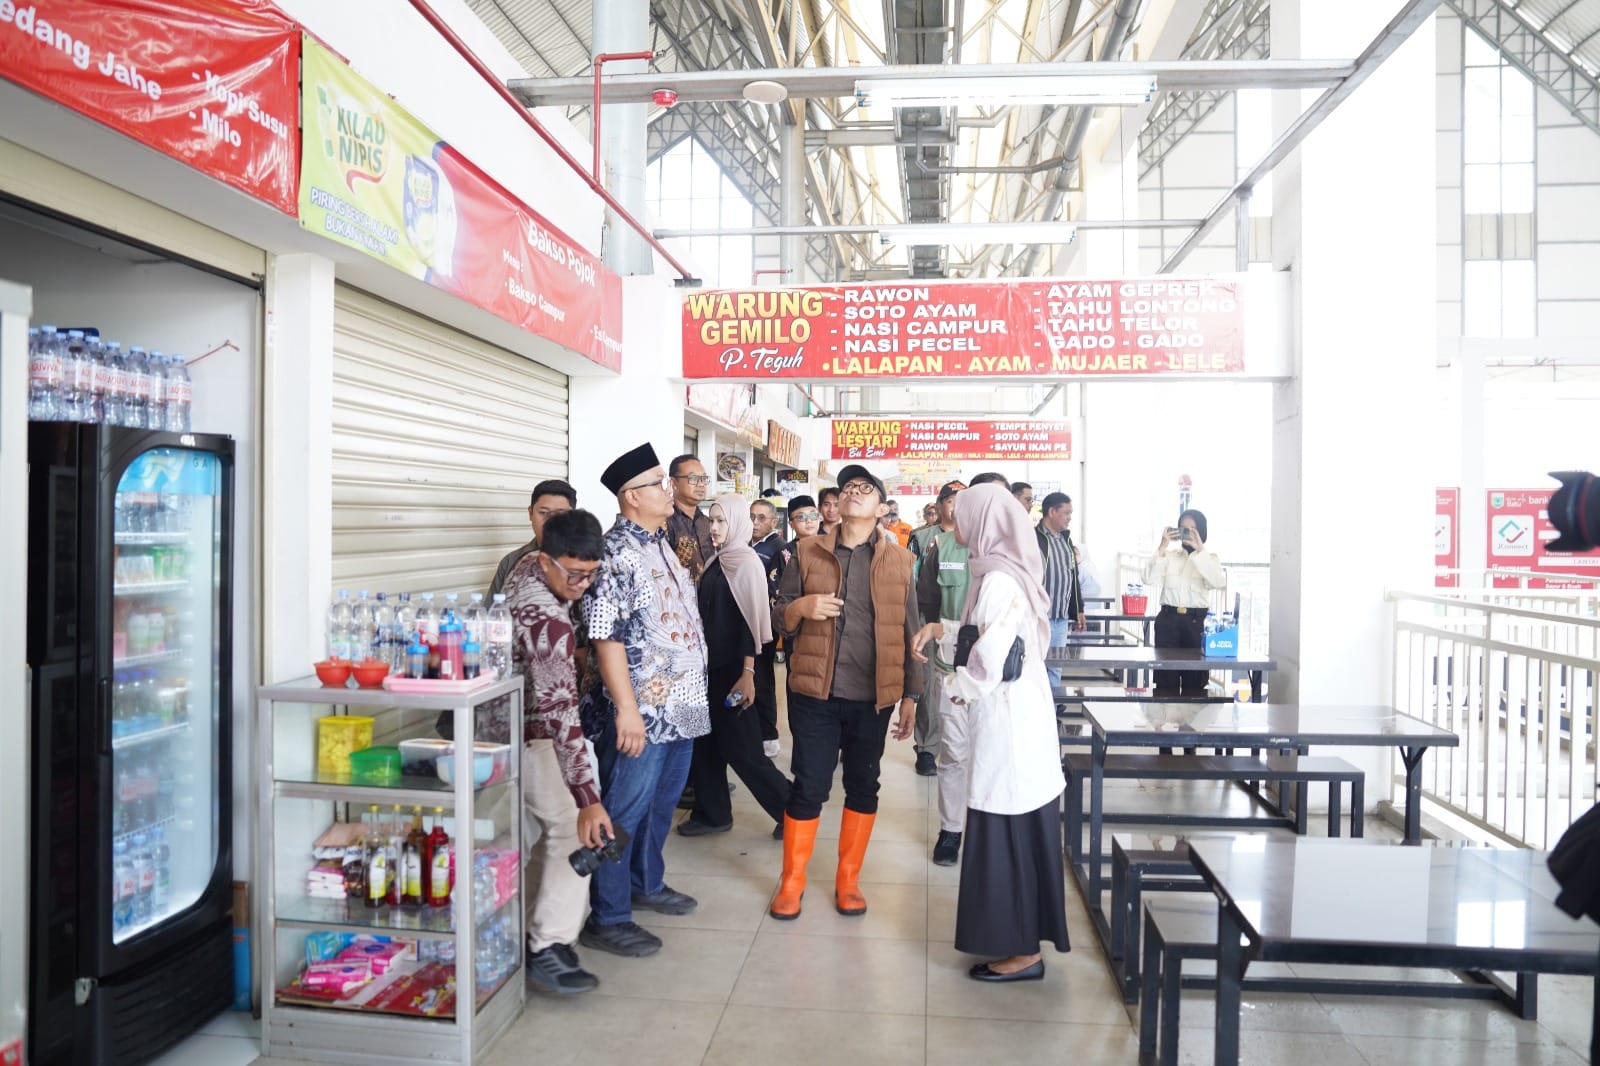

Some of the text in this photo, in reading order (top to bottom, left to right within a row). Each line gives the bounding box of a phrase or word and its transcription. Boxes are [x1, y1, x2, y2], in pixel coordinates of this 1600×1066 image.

[98, 52, 162, 100] Jahe
[205, 70, 287, 139] Kopi Susu
[202, 108, 241, 147] Milo
[337, 106, 385, 146] KILAU
[339, 136, 382, 173] NIPIS
[311, 188, 345, 214] PIRING
[528, 218, 596, 287] Bakso Pojok
[844, 288, 929, 302] RAWON
[1047, 283, 1217, 298] AYAM GEPREK
[509, 278, 565, 322] Bakso Campur
[688, 292, 823, 320] WARUNG
[1048, 300, 1236, 315] TAHU LONTONG
[844, 304, 976, 320] SOTO AYAM
[701, 318, 810, 345] GEMILO
[844, 320, 1007, 336] NASI CAMPUR
[1048, 316, 1200, 332] TAHU TELOR
[845, 338, 981, 352] NASI PECEL
[1050, 335, 1116, 350] GADO
[1137, 334, 1204, 348] GADO
[832, 356, 942, 374] LALAPAN
[968, 356, 1030, 372] AYAM
[1052, 354, 1148, 371] MUJAER
[1169, 353, 1225, 369] LELE
[834, 421, 901, 434] WARUNG
[838, 435, 898, 448] LESTARI
[848, 447, 862, 458] Bu
